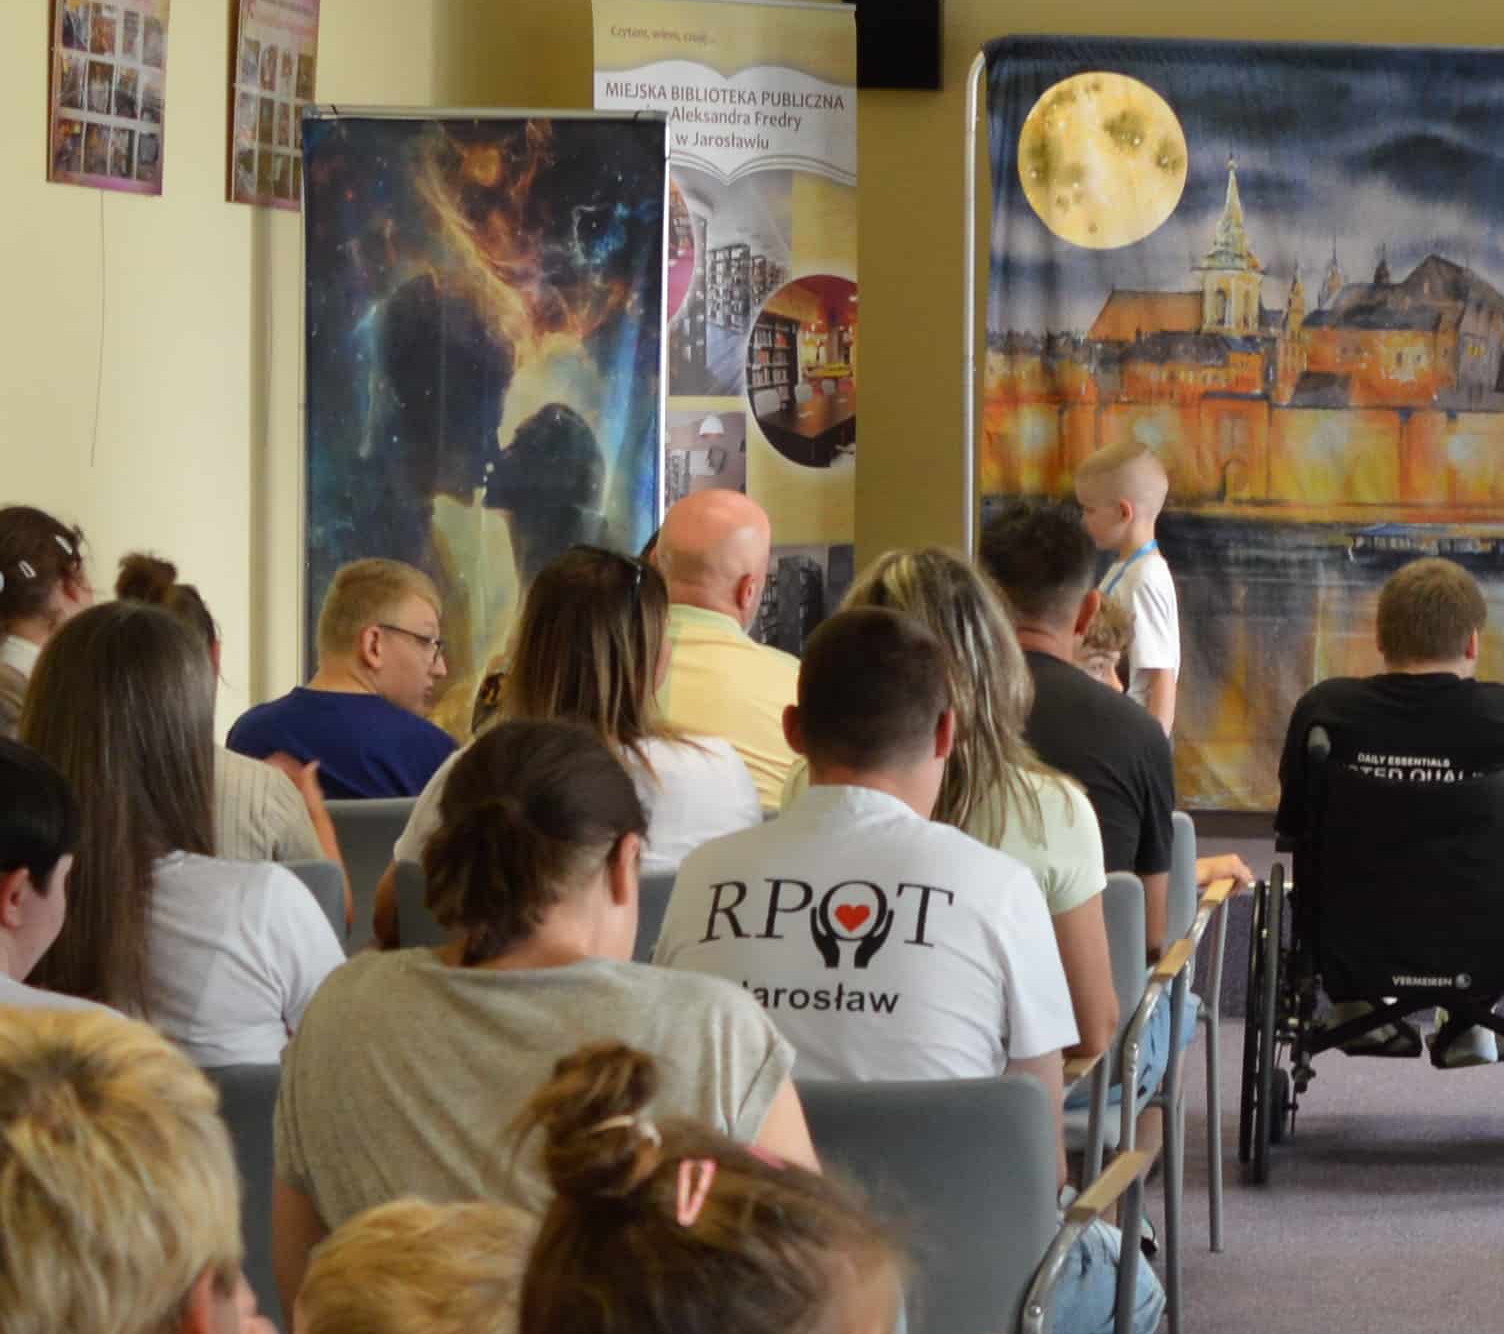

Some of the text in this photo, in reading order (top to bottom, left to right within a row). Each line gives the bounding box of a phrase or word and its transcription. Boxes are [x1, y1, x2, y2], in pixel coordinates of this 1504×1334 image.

[605, 81, 846, 110] MIEJSKA BIBLIOTEKA PUBLICZNA
[670, 106, 752, 126] Aleksandra
[754, 110, 803, 132] Fredry
[676, 131, 770, 151] w Jarosławiu
[1357, 751, 1451, 768] DAILY ESSENTIALS
[698, 876, 955, 948] RPOT
[742, 979, 899, 1014] arosław
